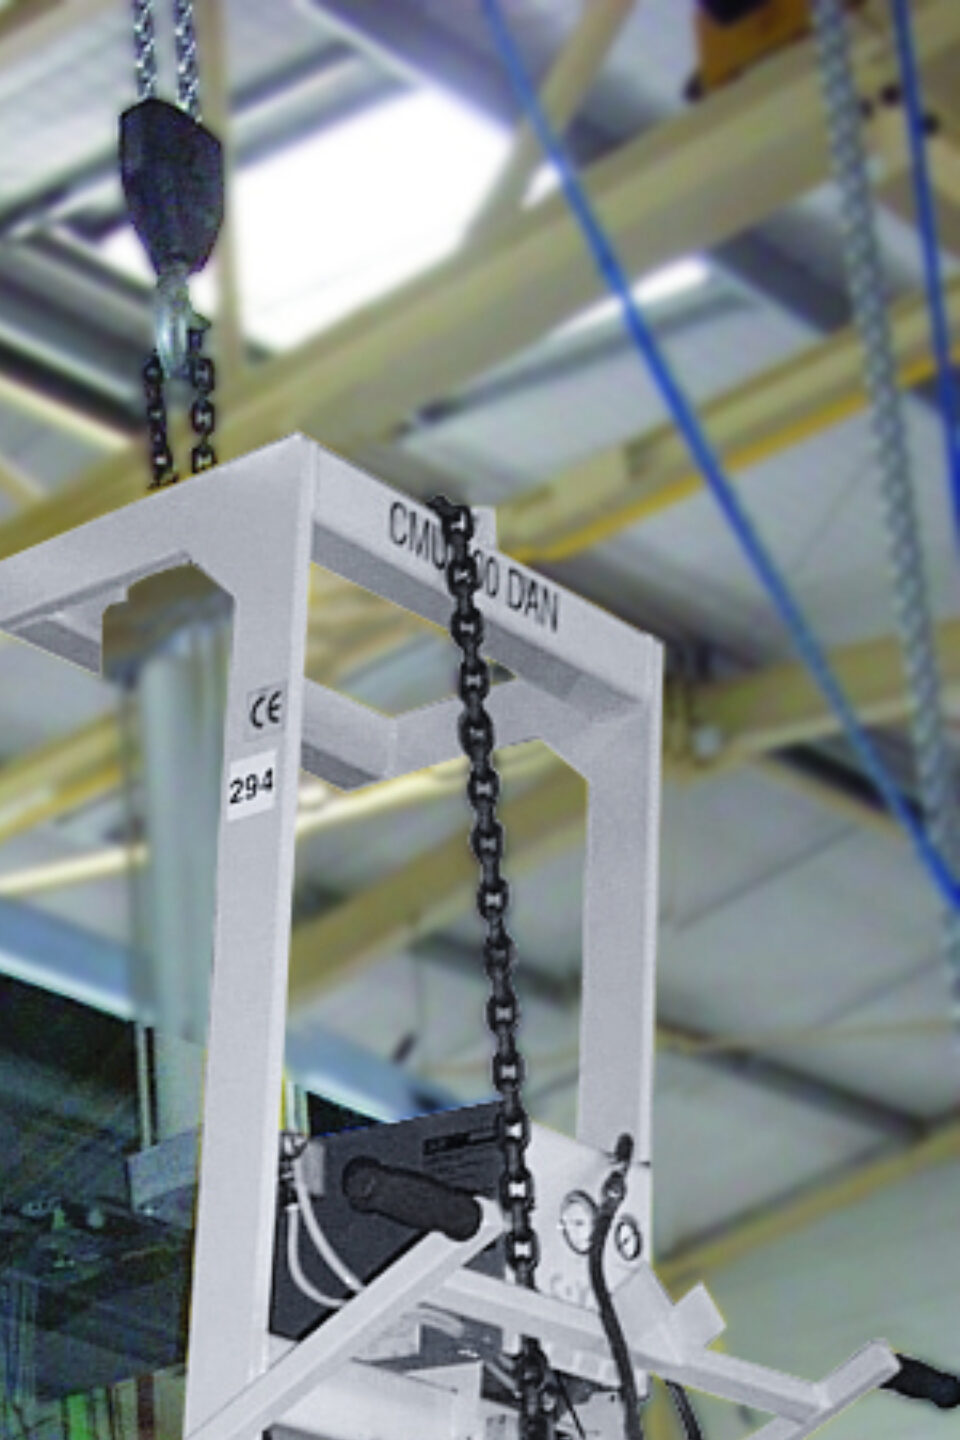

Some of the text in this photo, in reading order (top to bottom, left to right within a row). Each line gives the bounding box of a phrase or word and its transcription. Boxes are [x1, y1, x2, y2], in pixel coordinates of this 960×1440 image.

[389, 501, 451, 571] CMU
[507, 567, 558, 633] DAN
[249, 690, 282, 729] CE
[229, 767, 273, 804] 294
